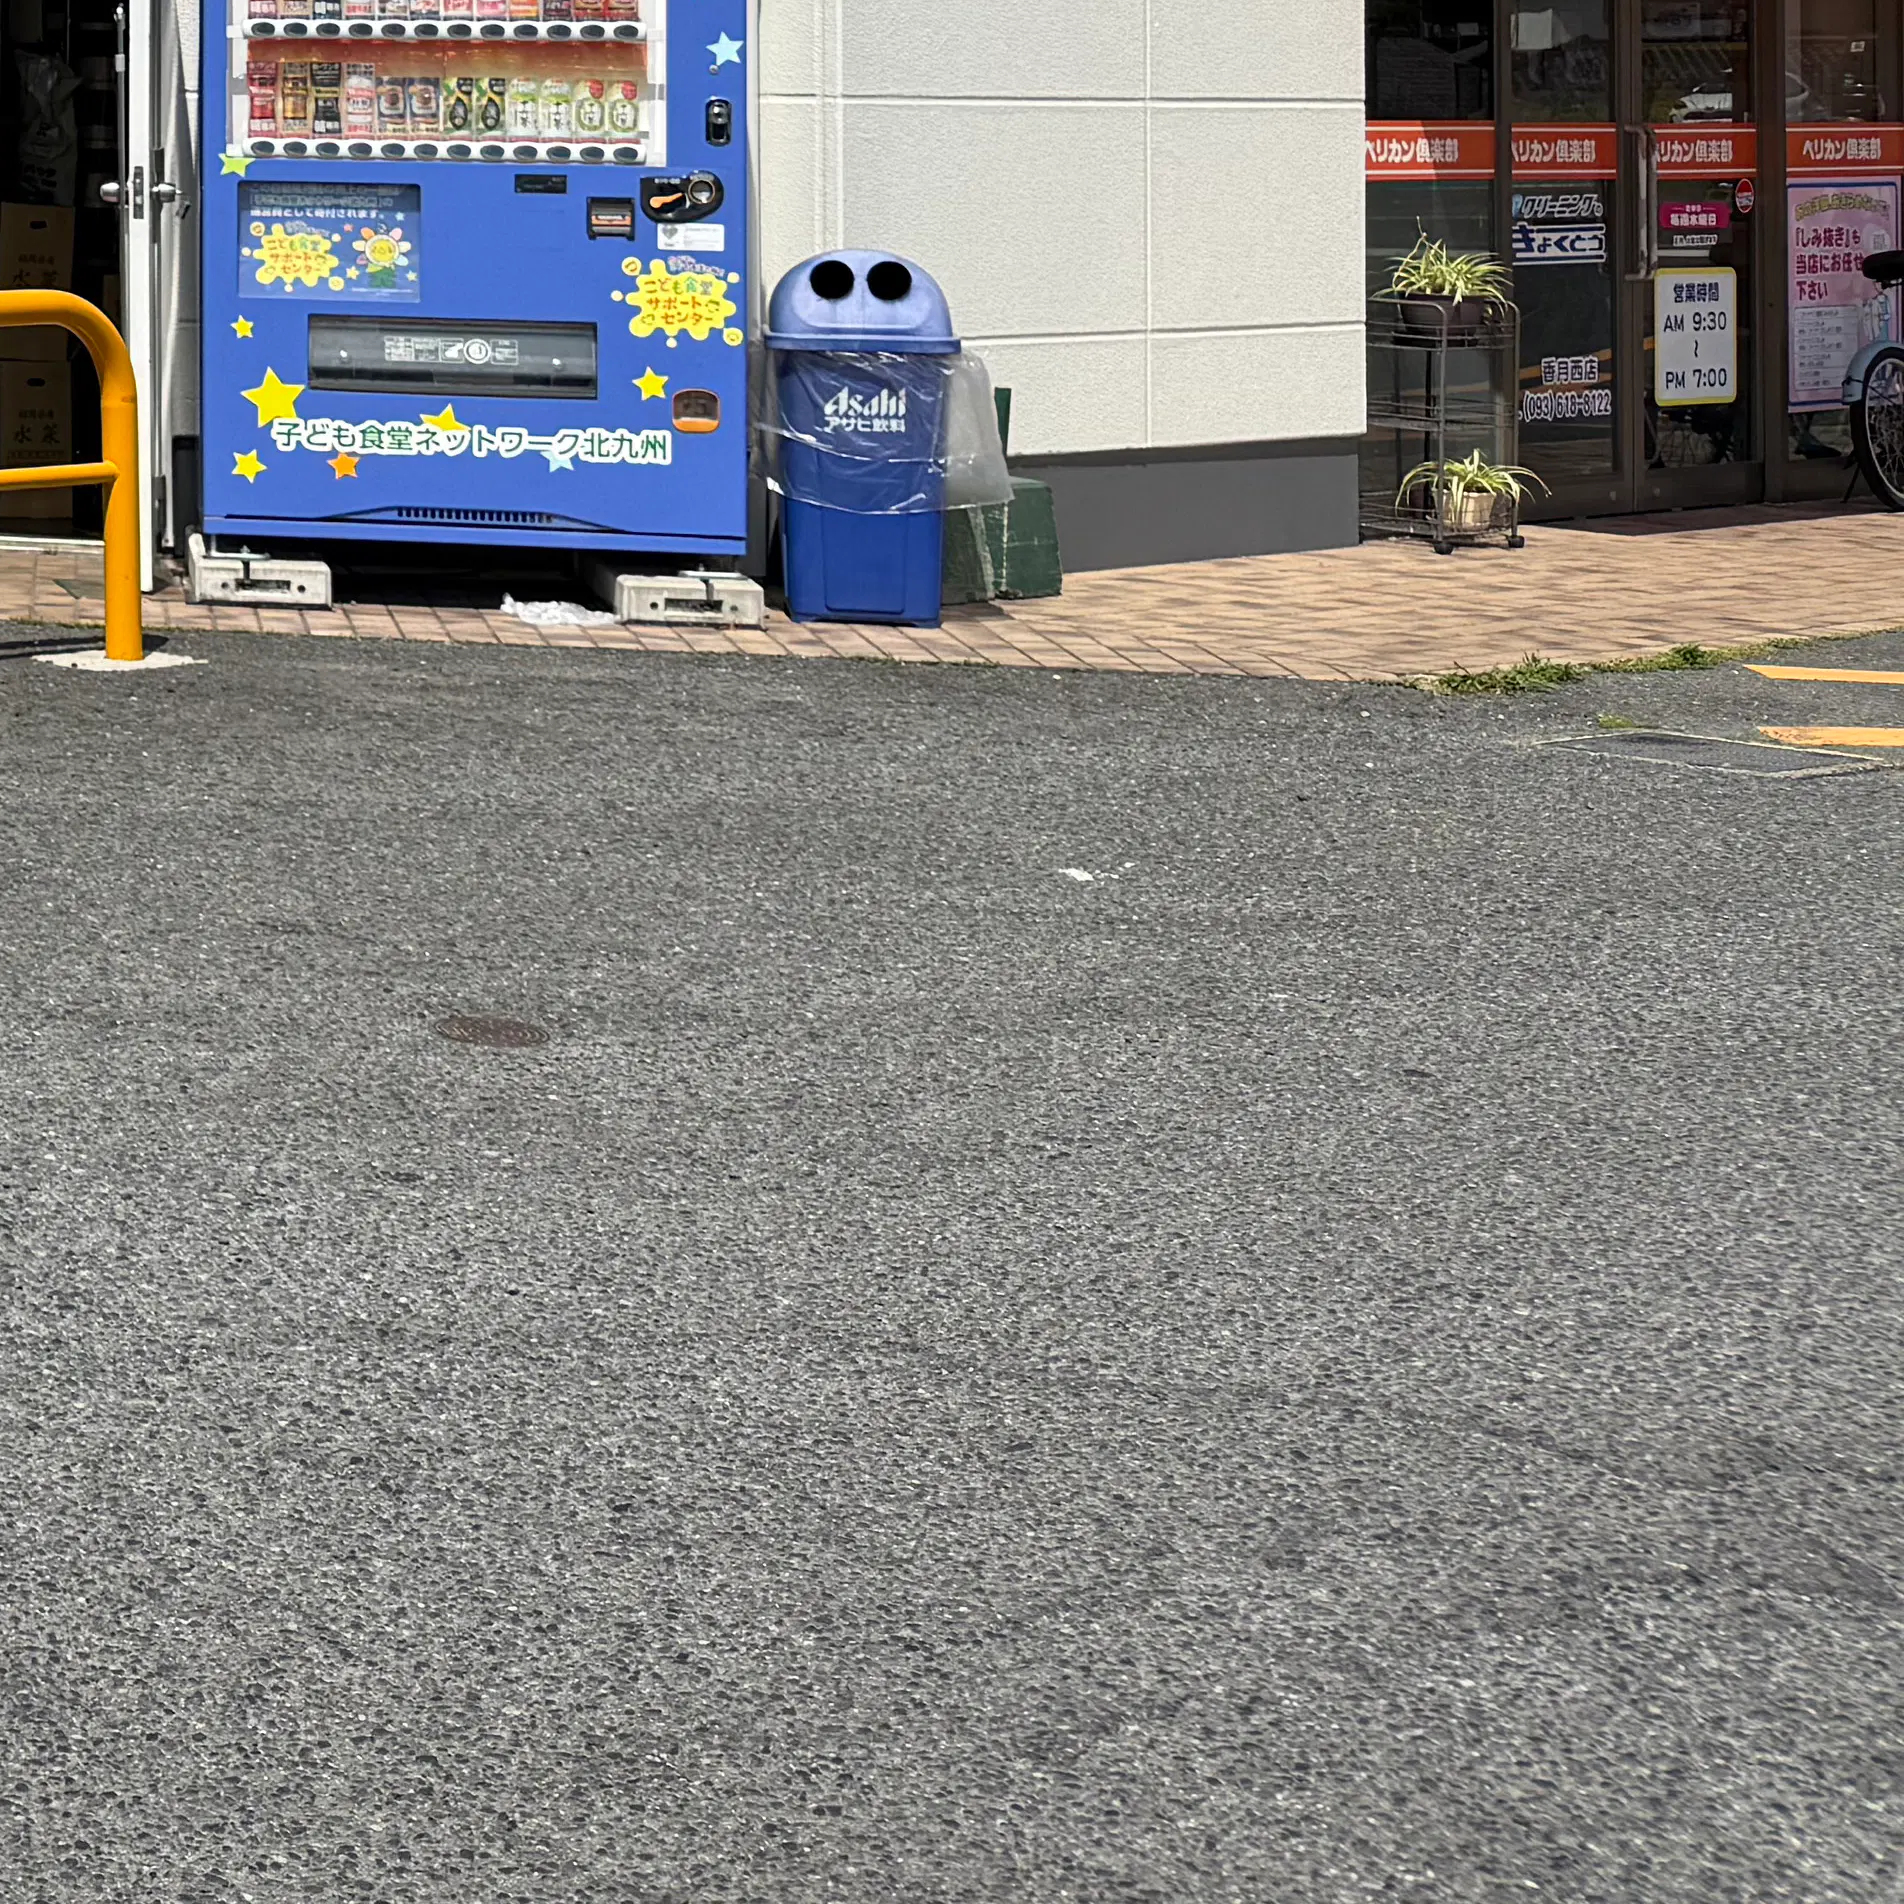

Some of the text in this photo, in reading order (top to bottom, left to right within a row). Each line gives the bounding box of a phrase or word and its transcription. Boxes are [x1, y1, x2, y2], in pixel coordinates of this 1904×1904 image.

[644, 276, 714, 296] こども食堂
[1673, 281, 1720, 303] 営業時間
[1796, 280, 1828, 301] 下さい
[646, 295, 703, 310] サポート
[660, 310, 714, 325] センター
[1663, 311, 1727, 332] AM 9:30
[1541, 355, 1599, 385] 香月西店
[1665, 367, 1728, 390] PM 7:00
[823, 386, 907, 417] Asahi
[823, 417, 905, 433] アサヒ飲料
[275, 420, 670, 462] 子ども食堂ネットワーク北九州
